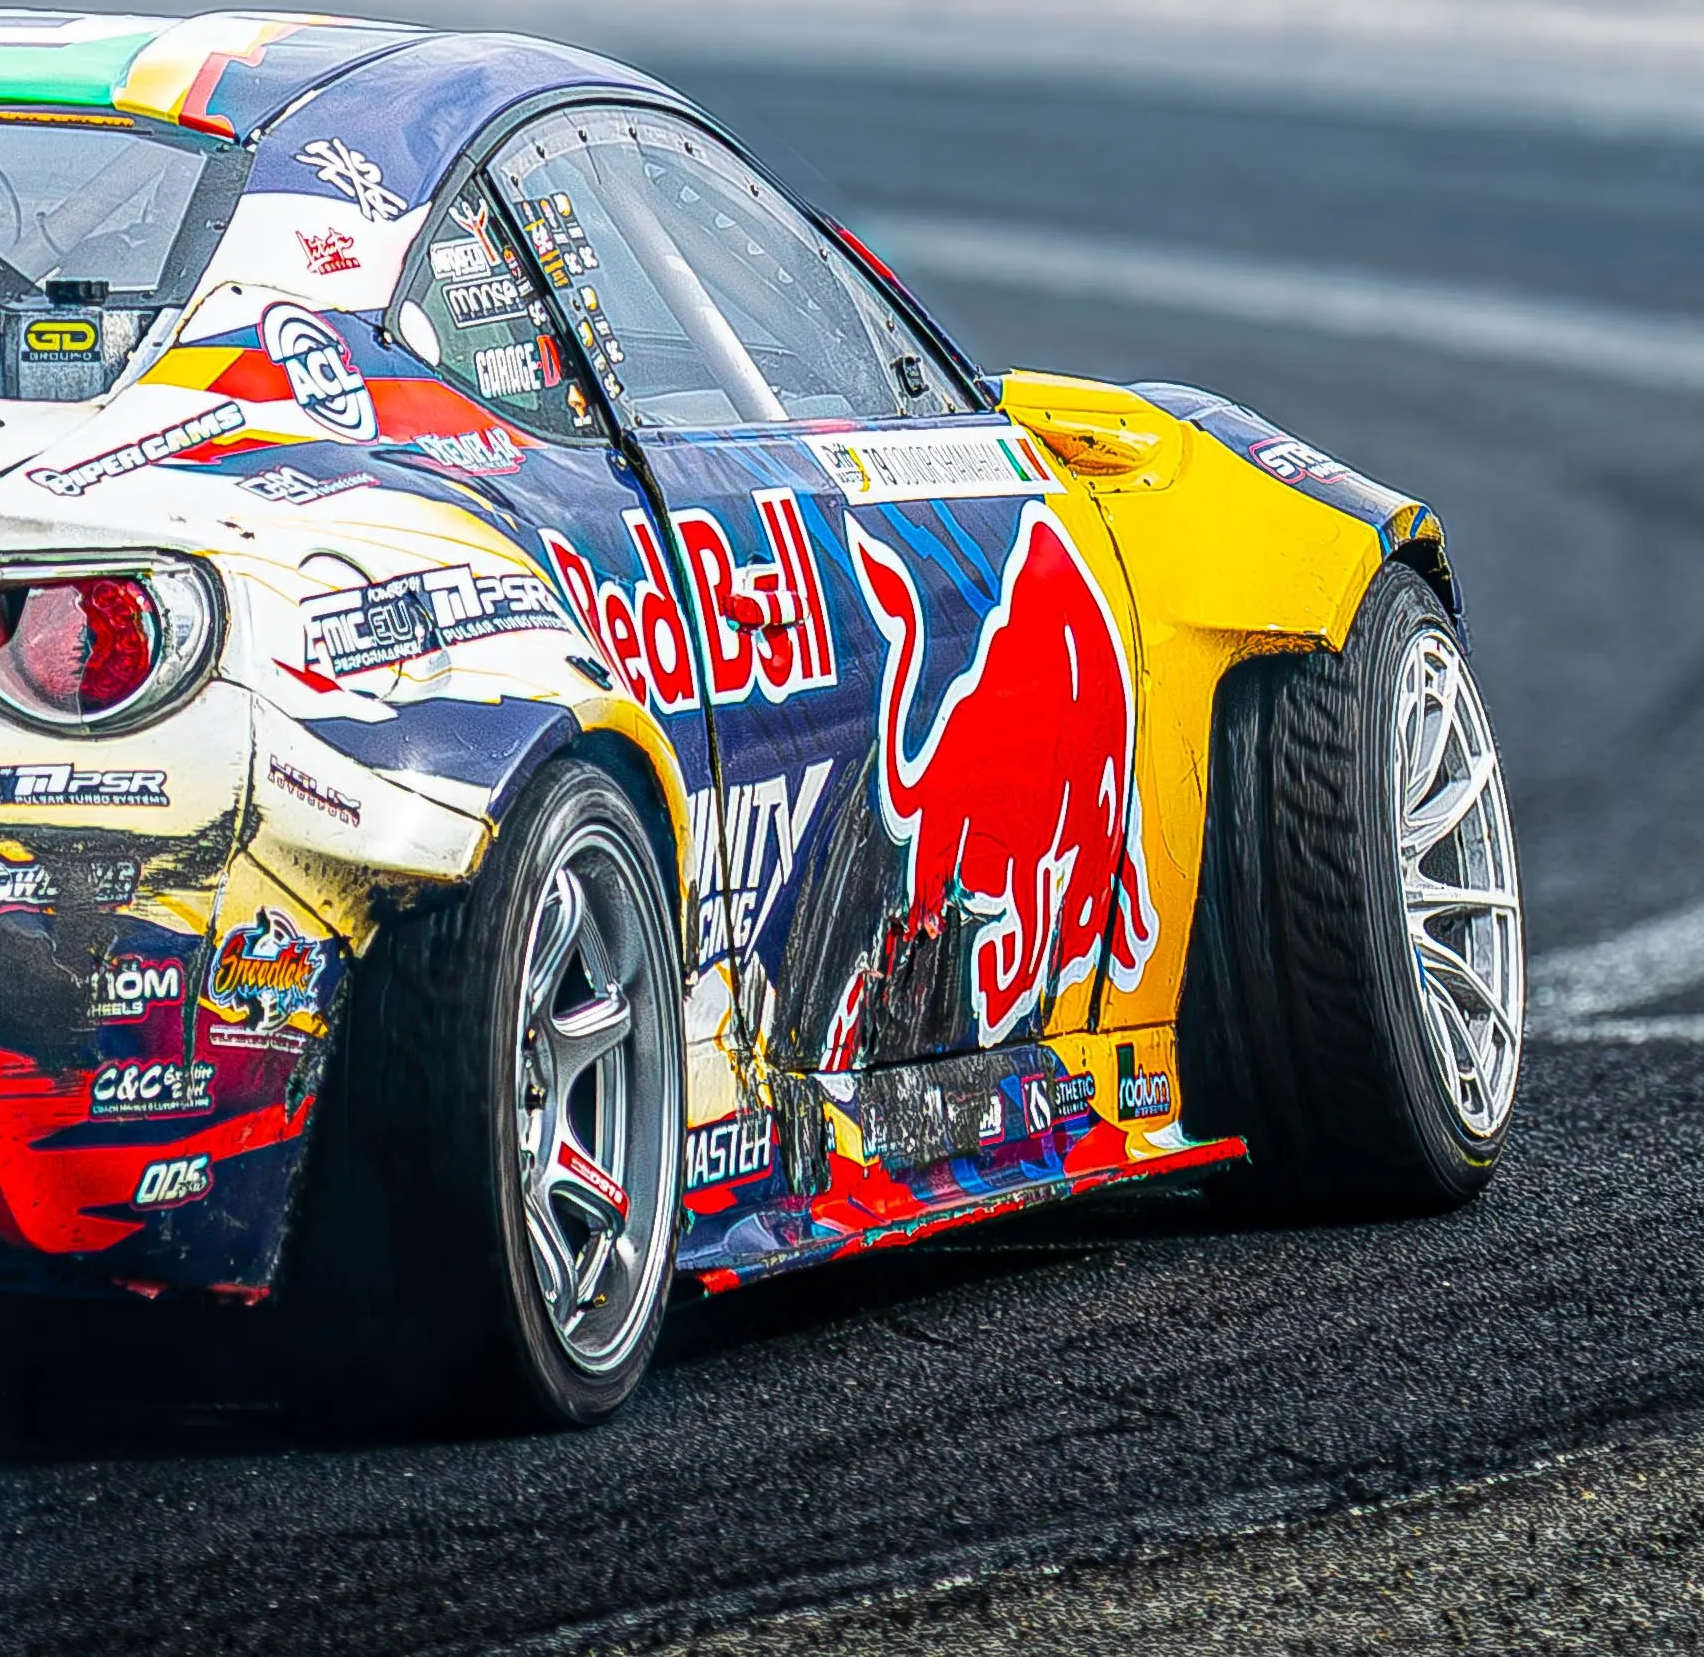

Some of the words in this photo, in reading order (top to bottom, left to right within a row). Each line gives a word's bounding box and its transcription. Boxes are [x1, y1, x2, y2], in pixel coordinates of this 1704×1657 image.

[286, 345, 362, 405] ACL
[140, 401, 246, 463] CAMS
[862, 447, 898, 485] 79
[928, 443, 1016, 484] SHANAHAN
[474, 575, 558, 615] PSR
[537, 509, 699, 713] Red
[671, 488, 837, 704] Bull
[444, 622, 496, 643] PULSAR
[69, 772, 166, 794] PSR
[698, 891, 757, 967] CING
[94, 1065, 162, 1100] C&C
[1055, 1076, 1094, 1105] STHETIC
